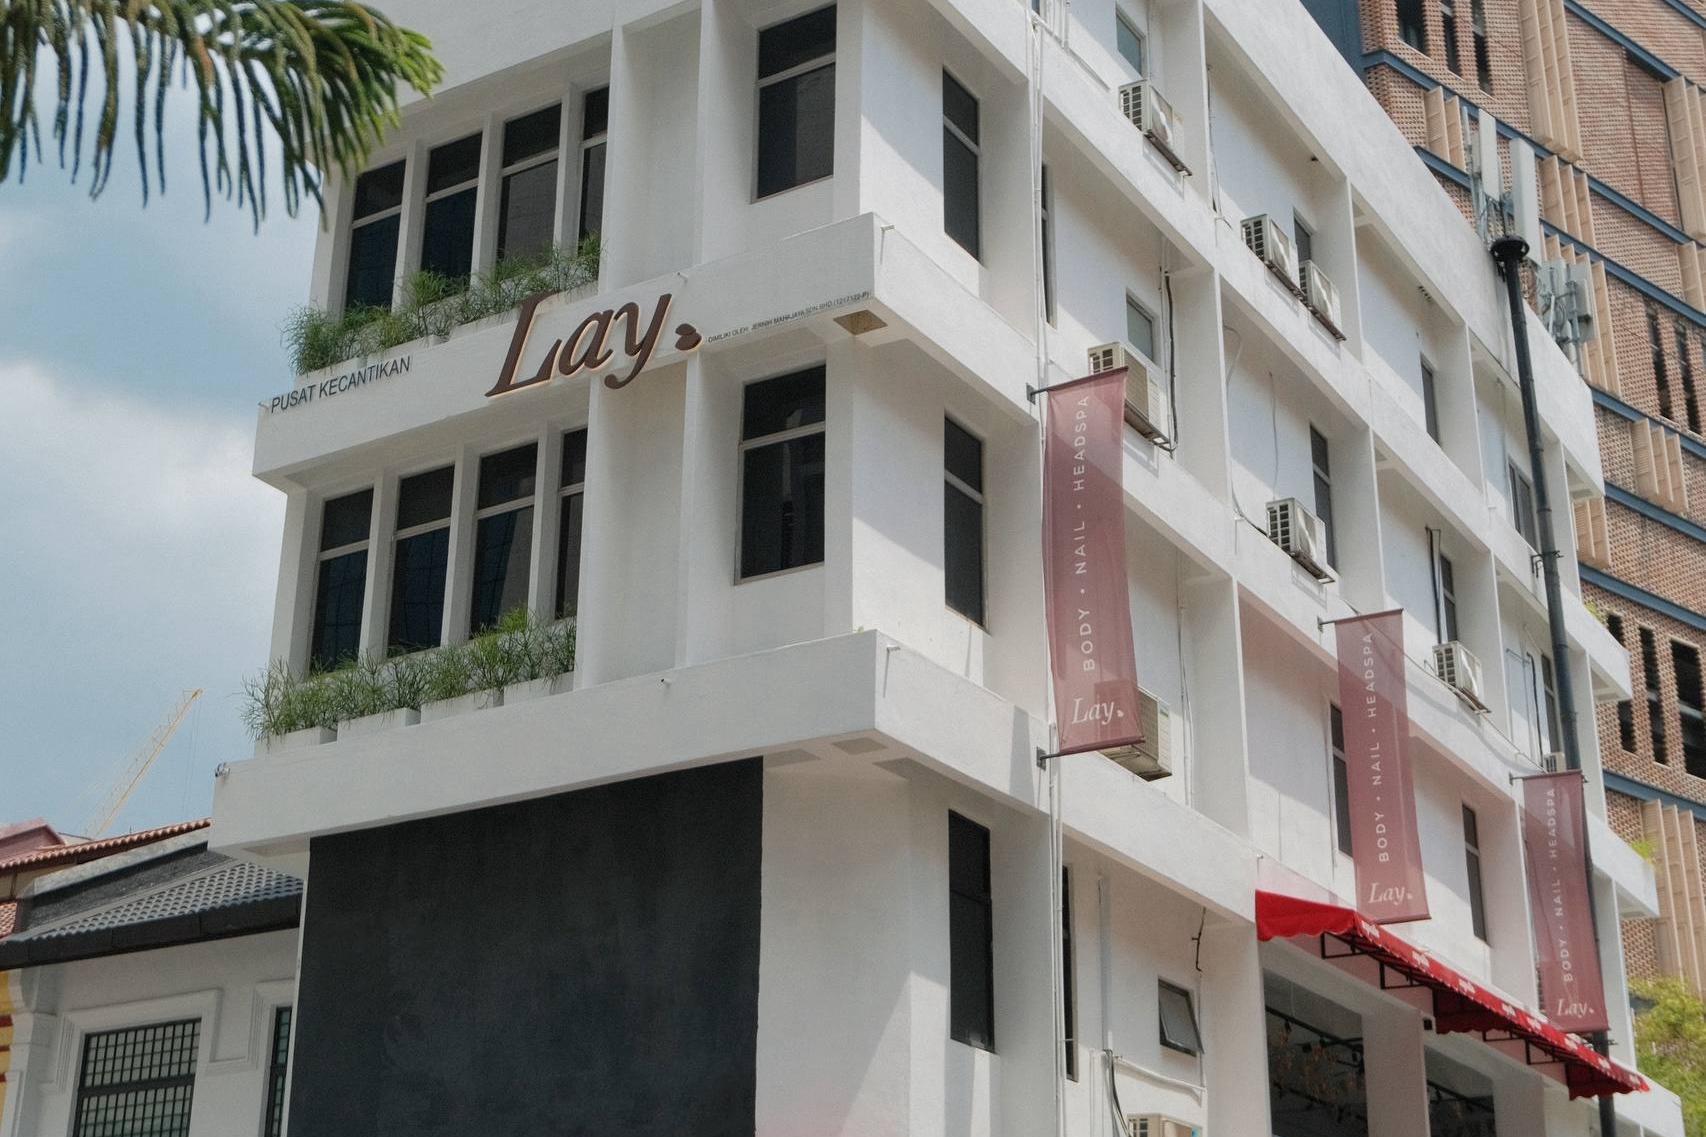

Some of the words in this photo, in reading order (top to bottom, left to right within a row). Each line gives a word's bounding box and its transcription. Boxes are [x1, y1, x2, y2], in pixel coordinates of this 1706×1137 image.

[271, 384, 317, 414] PUSAT
[319, 356, 410, 399] KECANTIKAN
[1073, 395, 1089, 491] HEADSPA
[1075, 519, 1087, 575] NAIL
[1080, 606, 1096, 672] BODY
[1362, 631, 1377, 718] HEADSPA
[1371, 740, 1383, 786] NAIL
[1374, 810, 1390, 863] BODY
[1546, 787, 1558, 859] HEADSPA
[1551, 877, 1564, 918] NAIL
[1558, 937, 1573, 983] BODY
